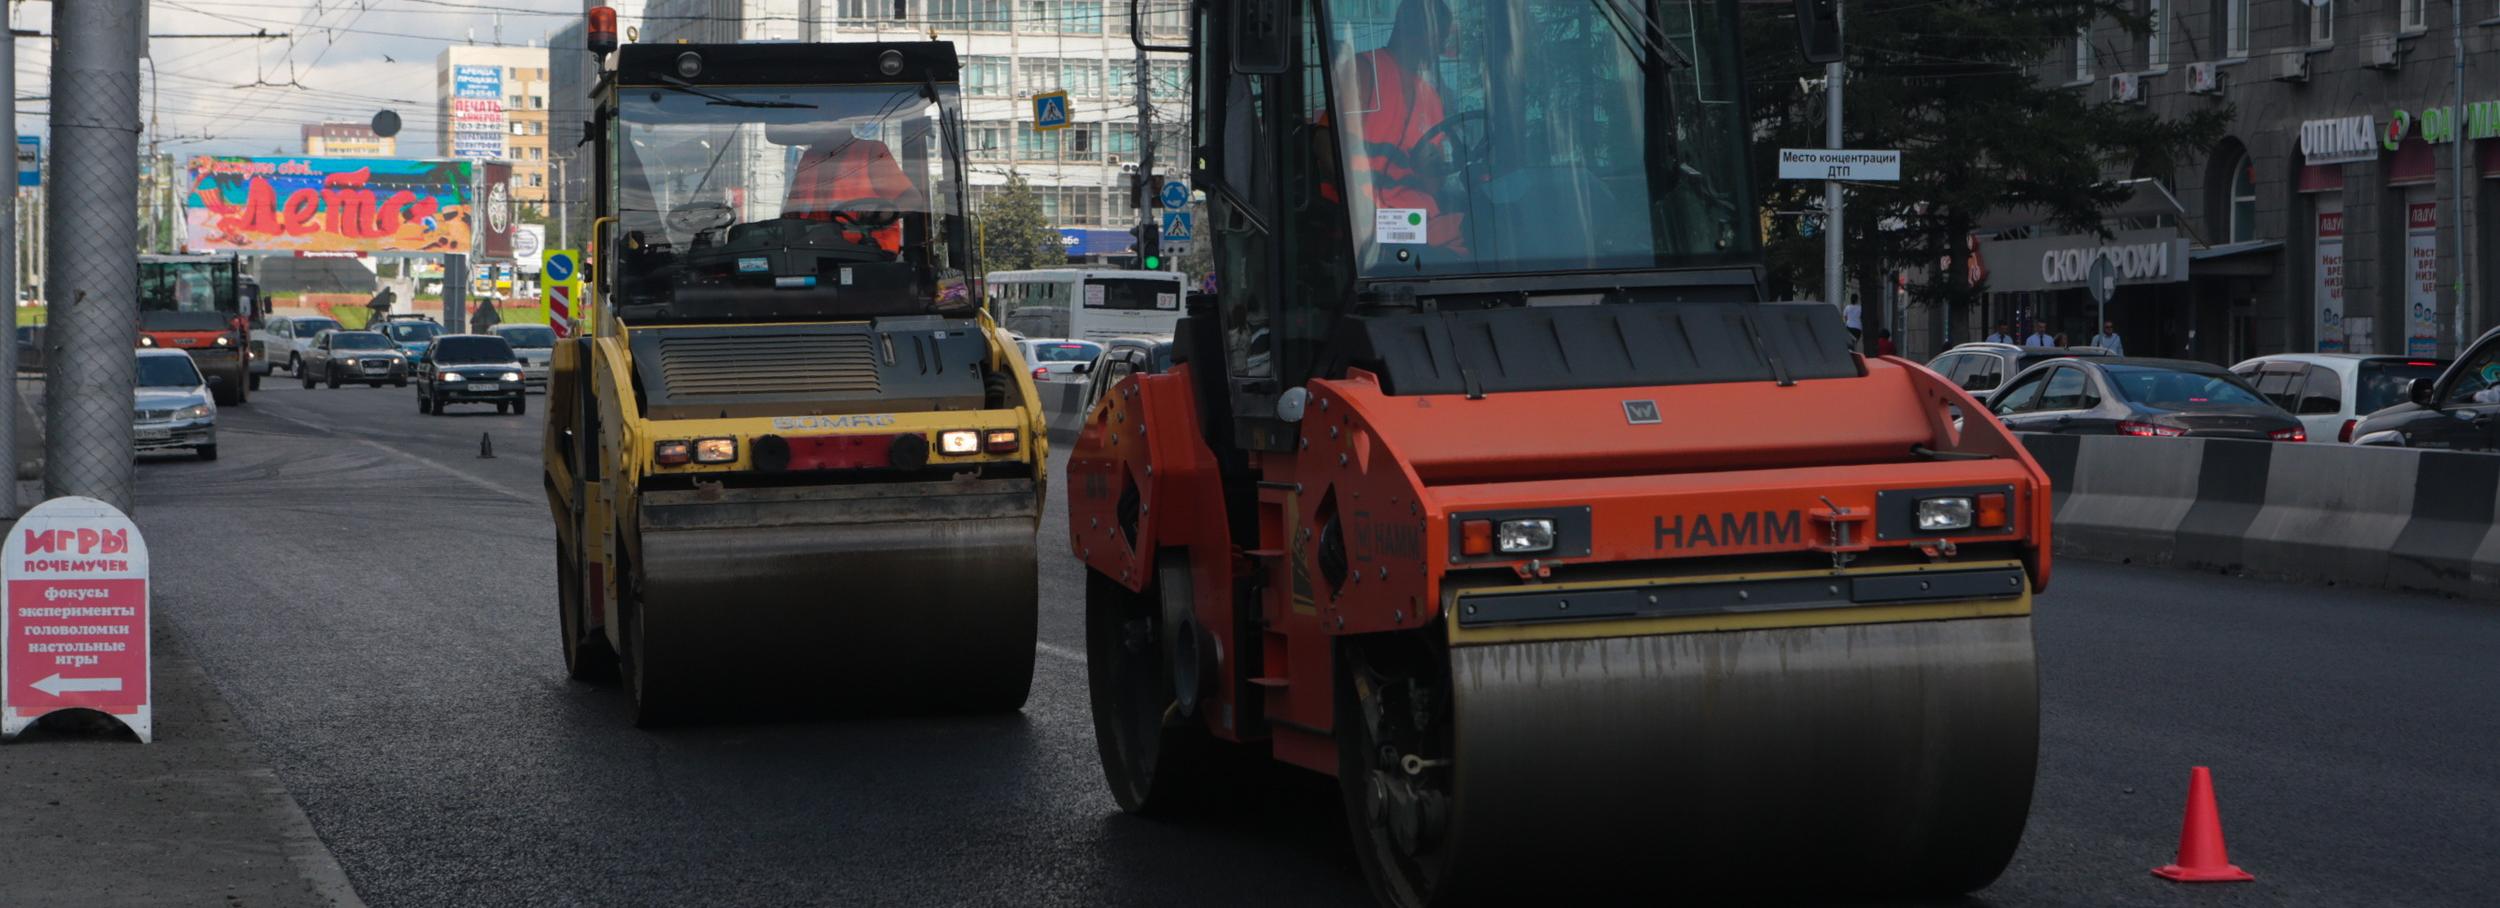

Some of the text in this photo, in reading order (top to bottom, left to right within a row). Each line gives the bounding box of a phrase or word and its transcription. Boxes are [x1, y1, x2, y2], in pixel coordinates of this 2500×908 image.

[455, 100, 501, 112] ПЕЧАТЬ
[2301, 105, 2377, 155] ОПТИКА
[1783, 151, 1896, 165] Место концентрации
[1827, 165, 1851, 177] ДТП
[1159, 295, 1174, 305] 97
[1653, 509, 1800, 550] HAMM
[25, 528, 128, 555] ИГРЫ
[24, 560, 128, 572] ПОЧЕМУЧЕК
[44, 587, 109, 601] фокусы
[18, 606, 135, 619] эксперименты
[24, 625, 129, 636] головоломки
[28, 641, 126, 653] настольные
[55, 655, 98, 667] игры
